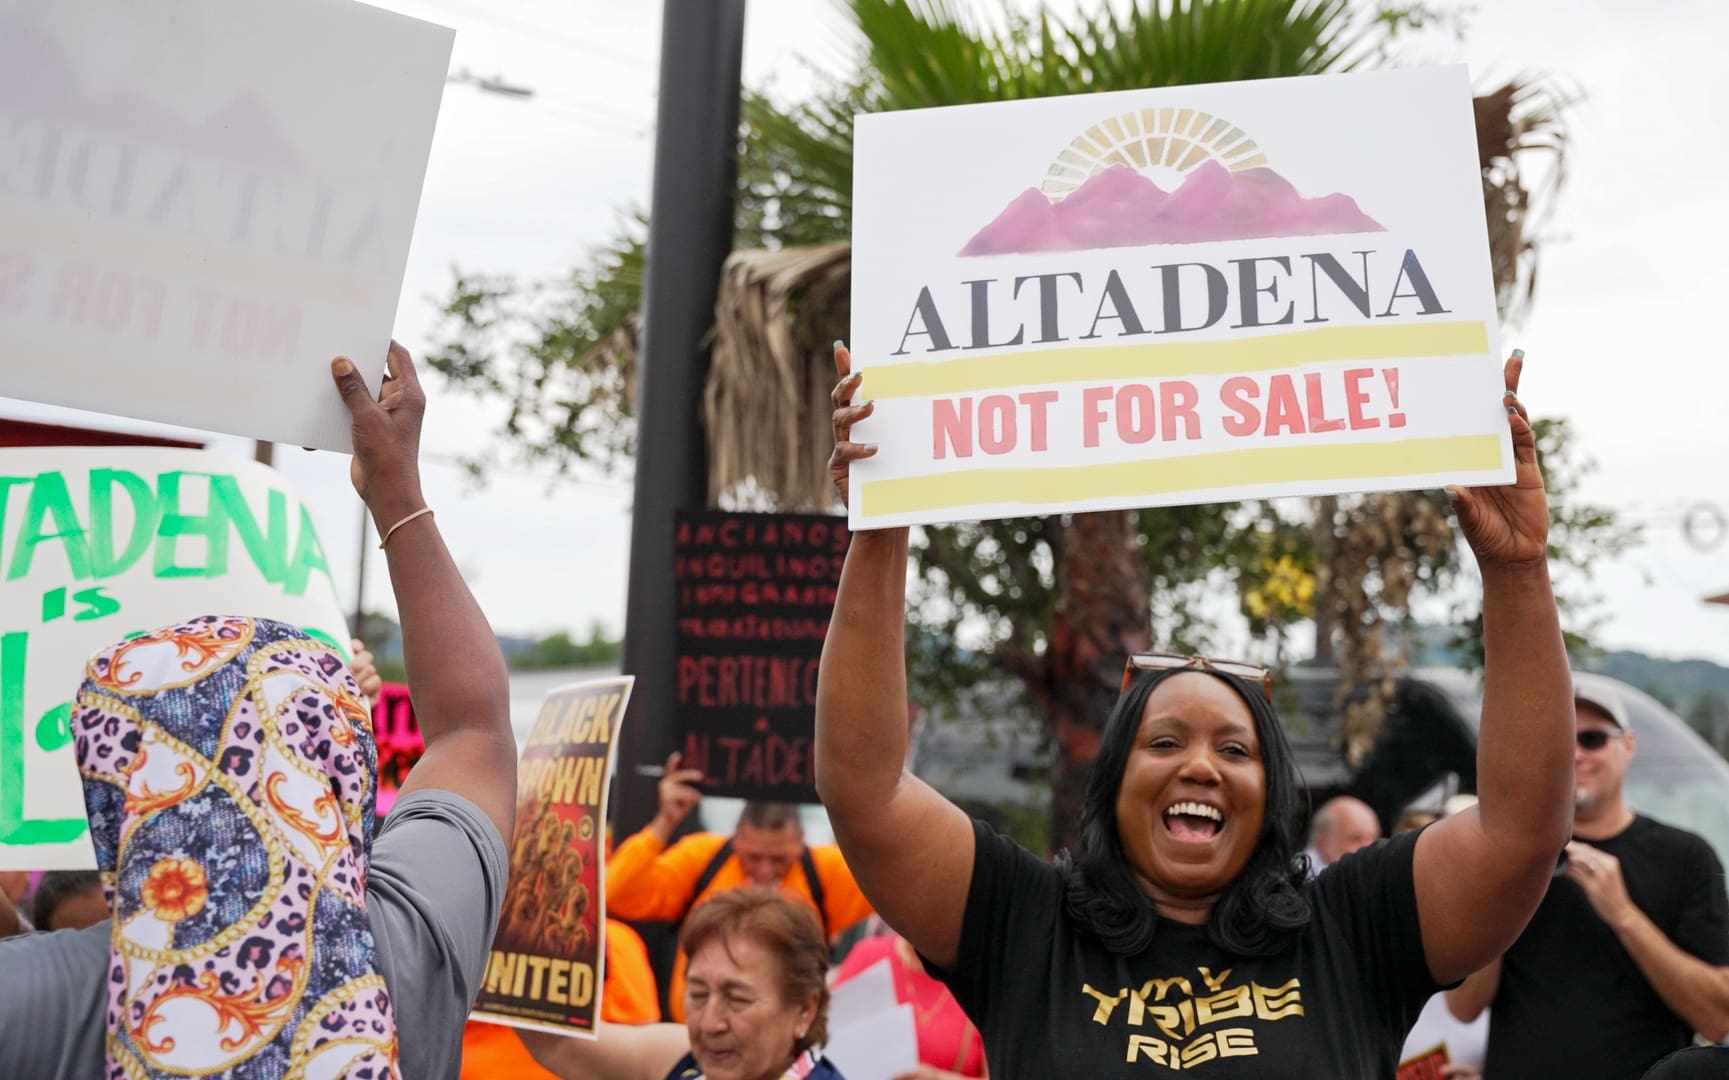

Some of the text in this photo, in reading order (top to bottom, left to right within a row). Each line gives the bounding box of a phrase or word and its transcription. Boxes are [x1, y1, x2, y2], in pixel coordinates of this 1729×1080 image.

[891, 249, 1452, 355] ALTADENA
[932, 367, 1408, 460] NOT FOR SALE!
[42, 586, 120, 623] IS
[480, 950, 594, 1007] NITED
[1126, 1028, 1259, 1071] RISE
